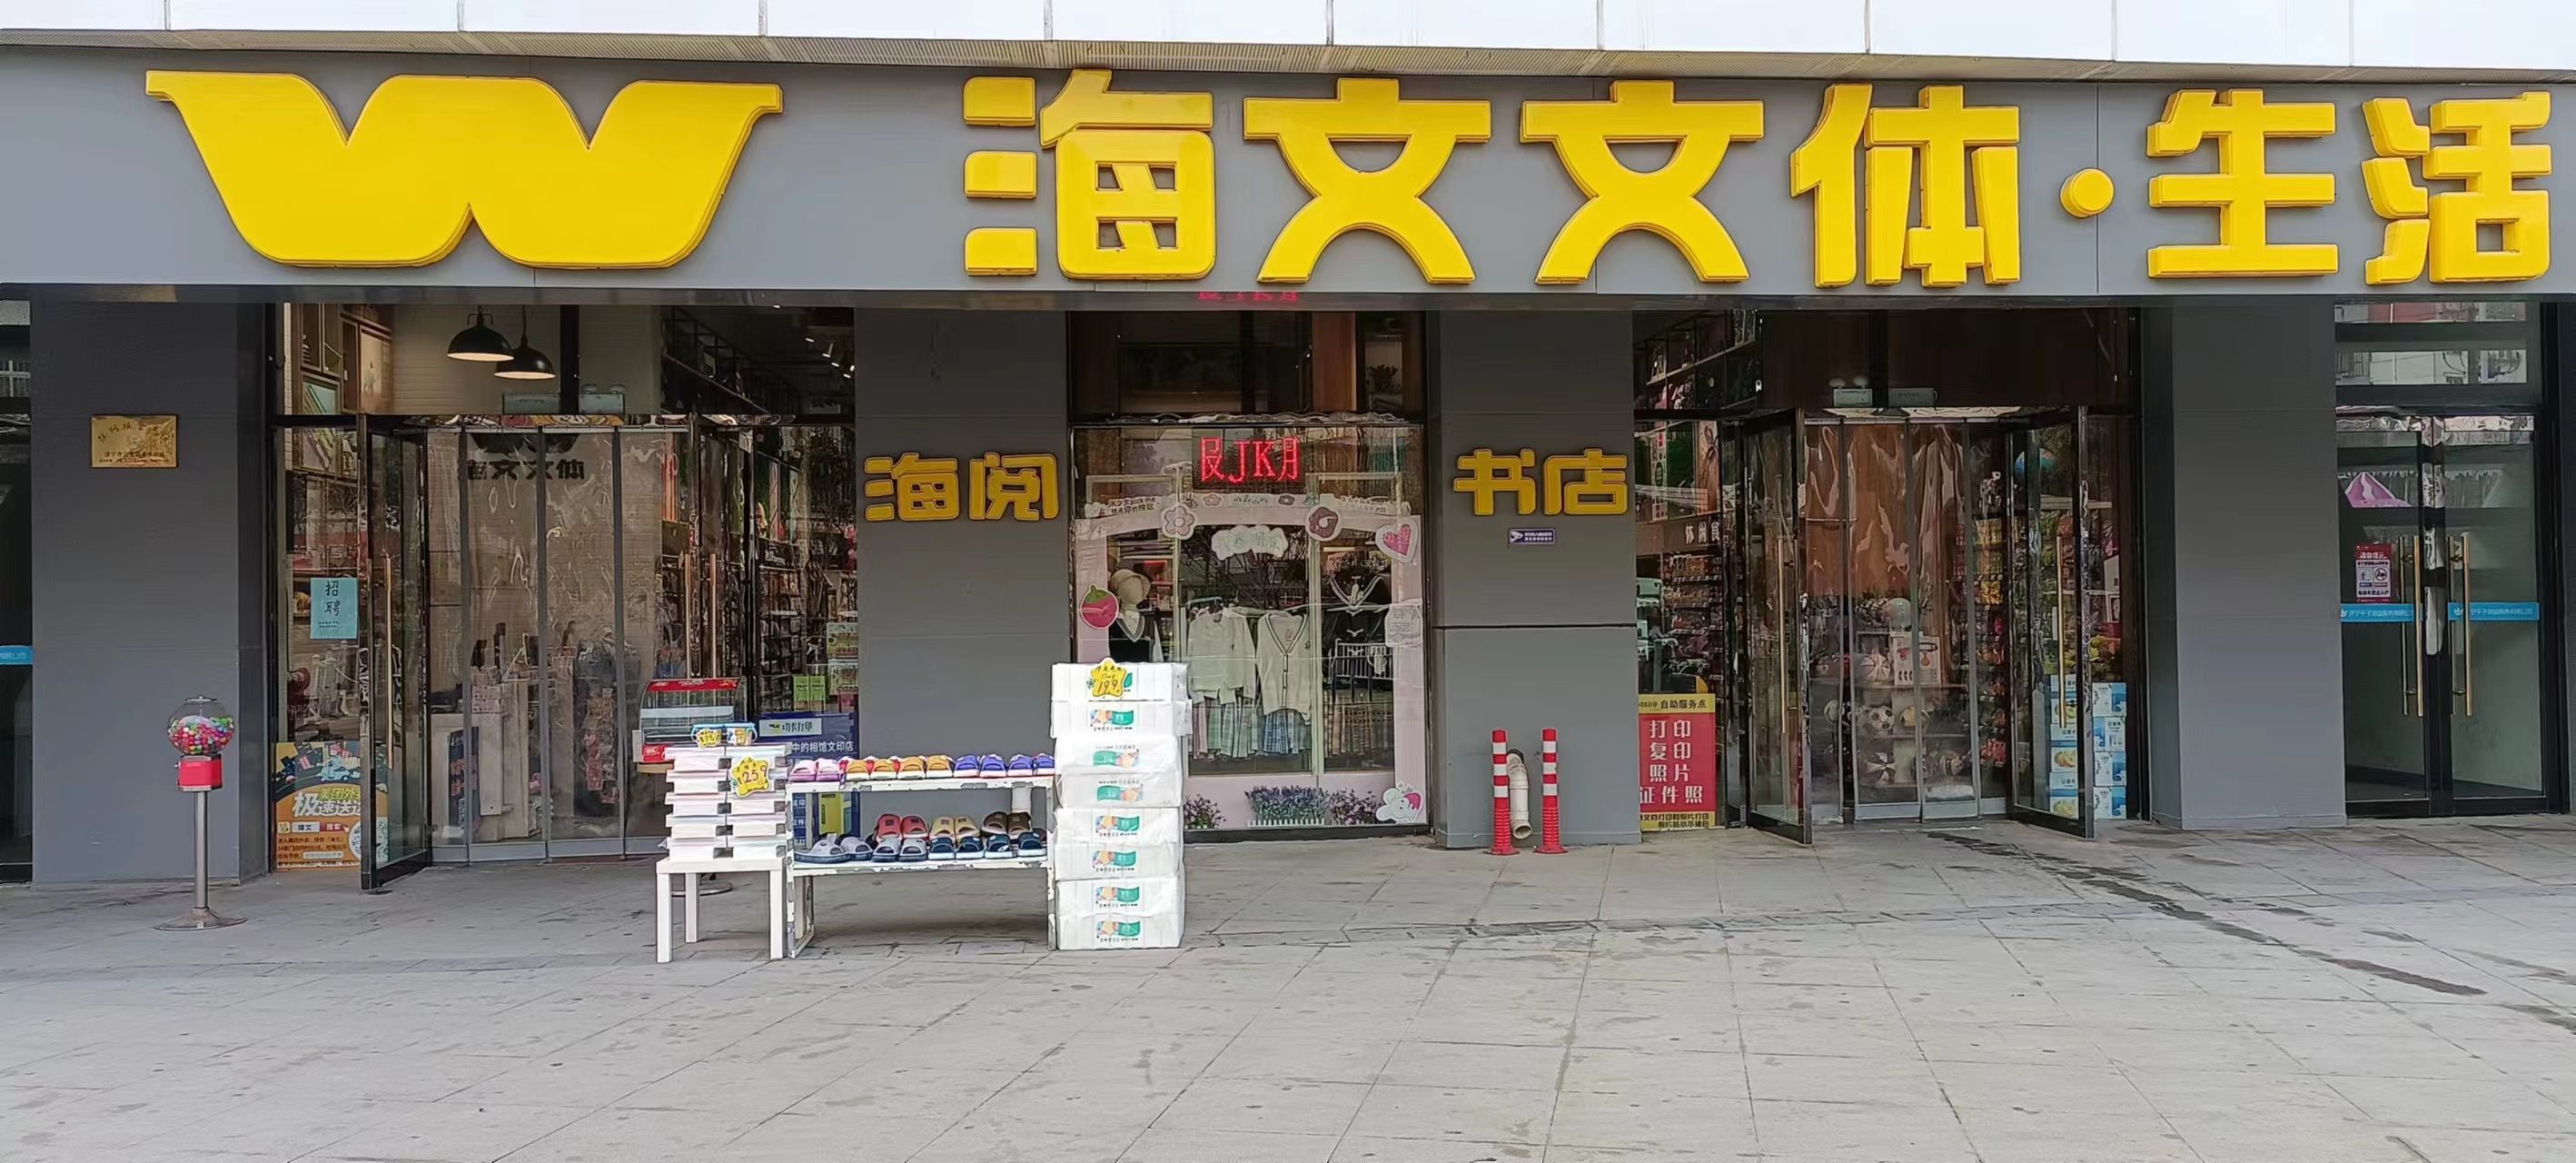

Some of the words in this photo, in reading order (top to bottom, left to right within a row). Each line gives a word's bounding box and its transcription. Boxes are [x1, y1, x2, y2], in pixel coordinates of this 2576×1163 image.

[864, 452, 1059, 522] 海阅
[1452, 448, 1629, 516] 书店
[324, 580, 341, 616] 招聘
[1660, 700, 1707, 710] 自助服务点
[1650, 720, 1691, 739] 打印
[1650, 741, 1691, 760] 复印
[1650, 763, 1691, 782] 照片
[1640, 785, 1703, 804] 证件照
